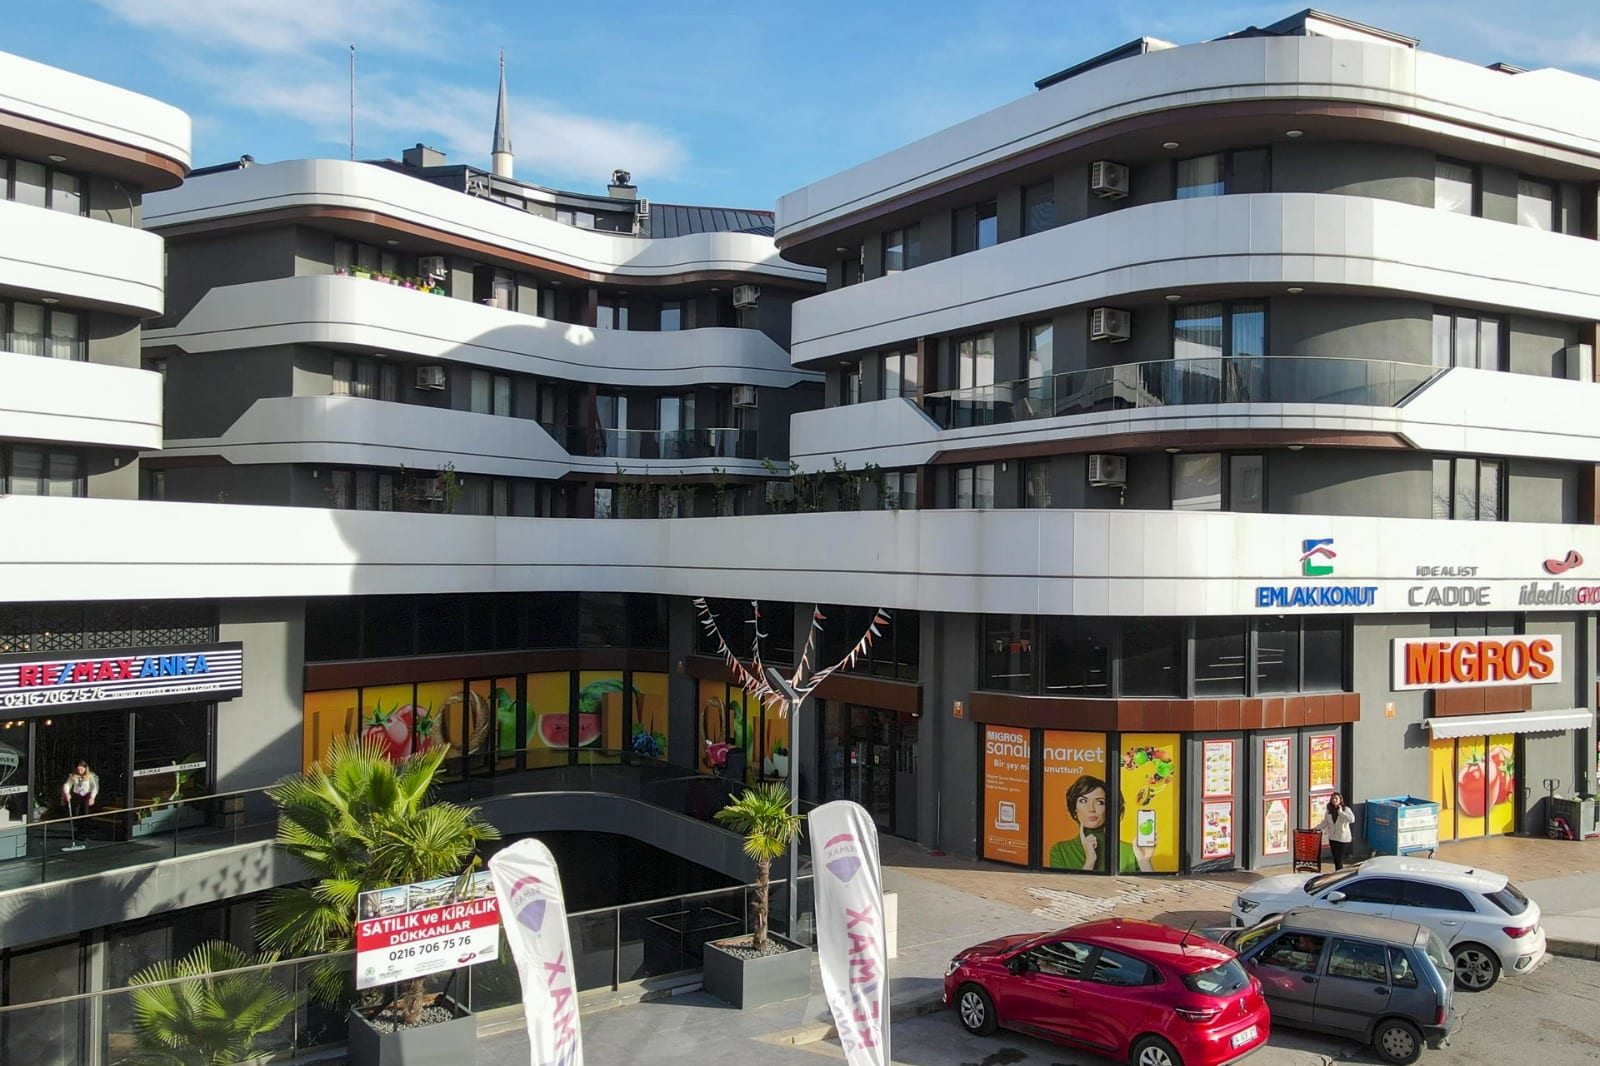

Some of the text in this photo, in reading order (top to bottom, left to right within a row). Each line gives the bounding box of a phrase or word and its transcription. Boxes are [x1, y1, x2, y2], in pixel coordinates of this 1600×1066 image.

[1408, 586, 1491, 607] CADDE
[19, 654, 210, 688] RE/MAX ANKA
[986, 740, 1027, 758] sanal
[362, 914, 420, 937] SATILIK
[422, 914, 438, 925] ve
[389, 935, 471, 961] 0216 706 75 76
